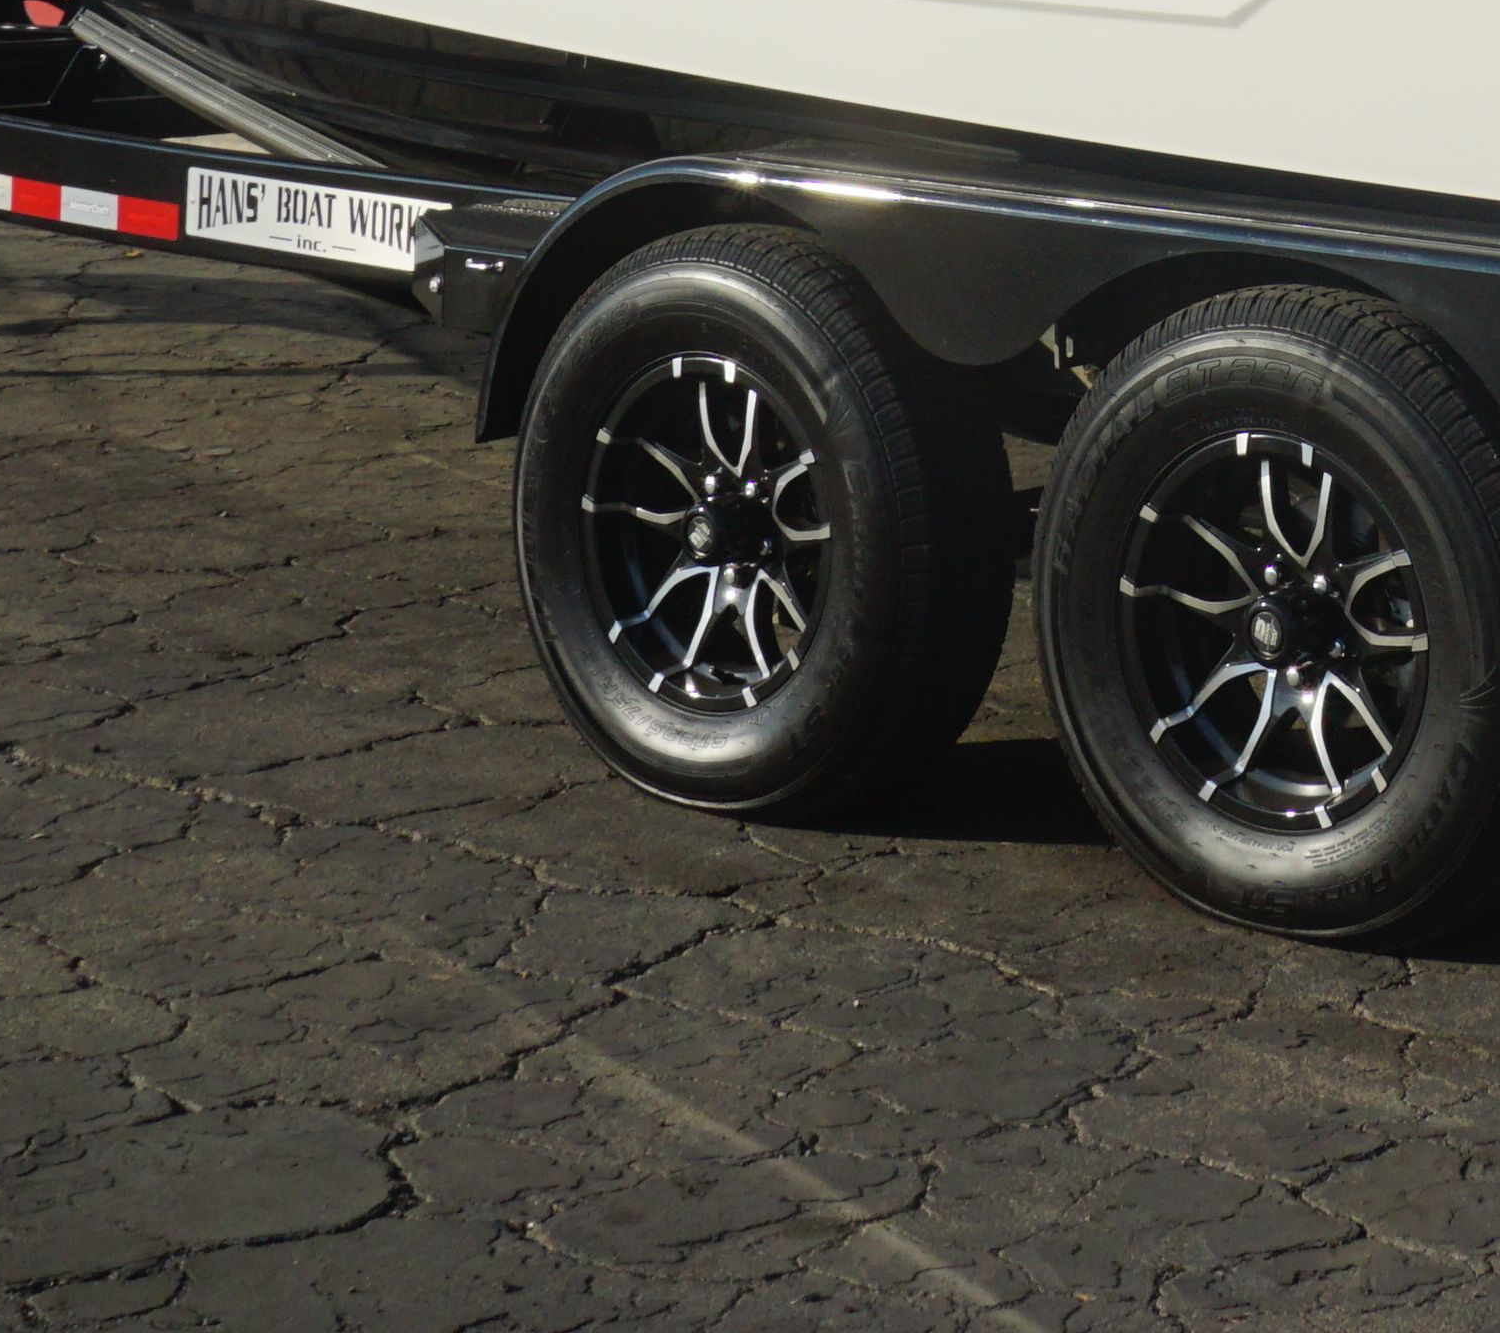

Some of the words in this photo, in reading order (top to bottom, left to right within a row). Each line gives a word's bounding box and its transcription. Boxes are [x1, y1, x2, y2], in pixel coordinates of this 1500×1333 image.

[197, 173, 266, 231] HANS'
[276, 185, 337, 229] BOAT
[297, 234, 327, 253] inc.
